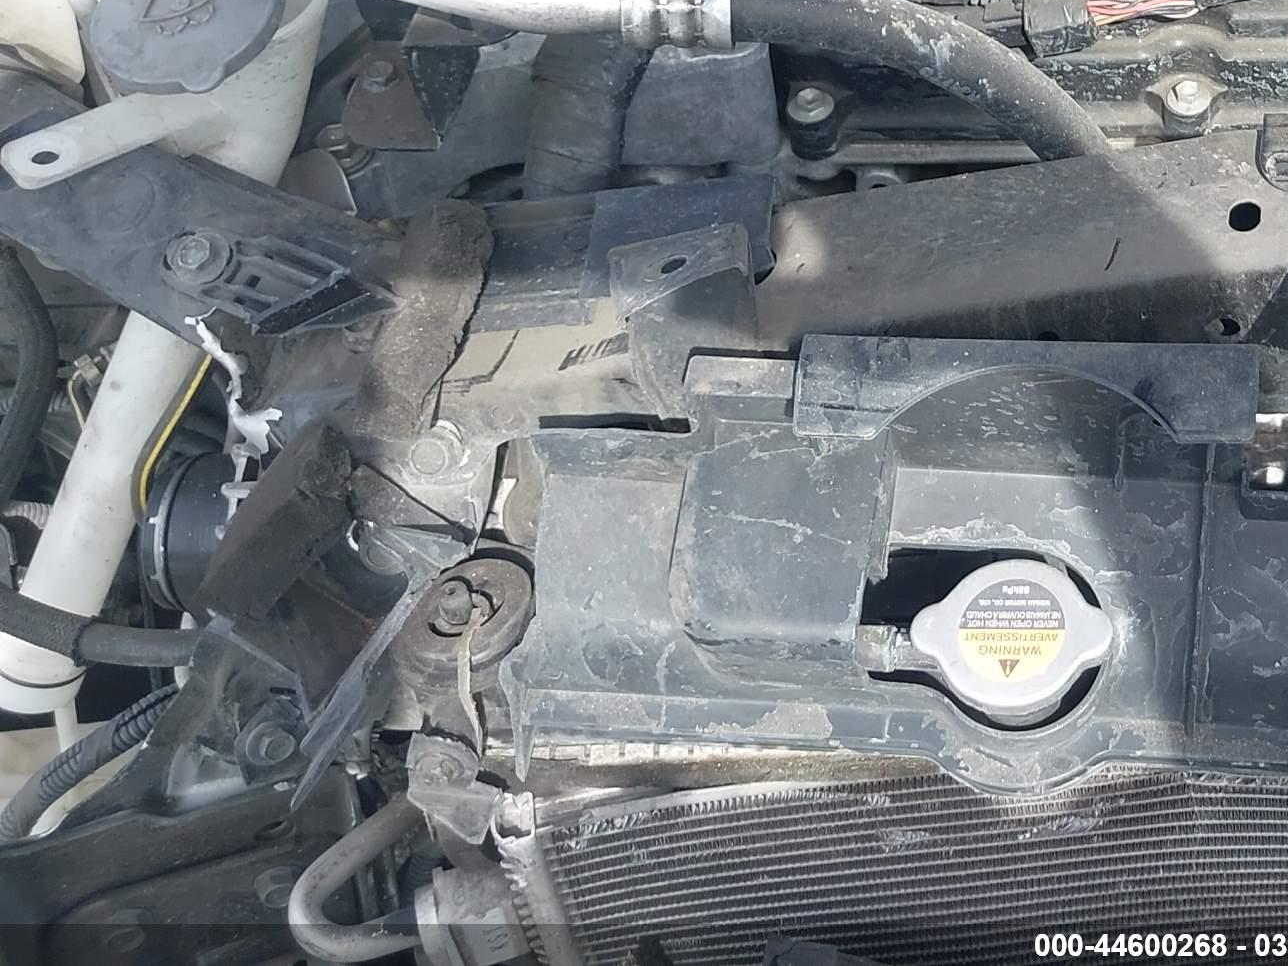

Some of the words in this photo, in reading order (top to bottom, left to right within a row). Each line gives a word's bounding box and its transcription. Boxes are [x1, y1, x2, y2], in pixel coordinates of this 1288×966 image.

[985, 619, 1010, 628] WHEN
[1011, 619, 1032, 628] OPEN
[965, 632, 1058, 642] AVERTISSEMENT
[978, 644, 1042, 655] WARNING
